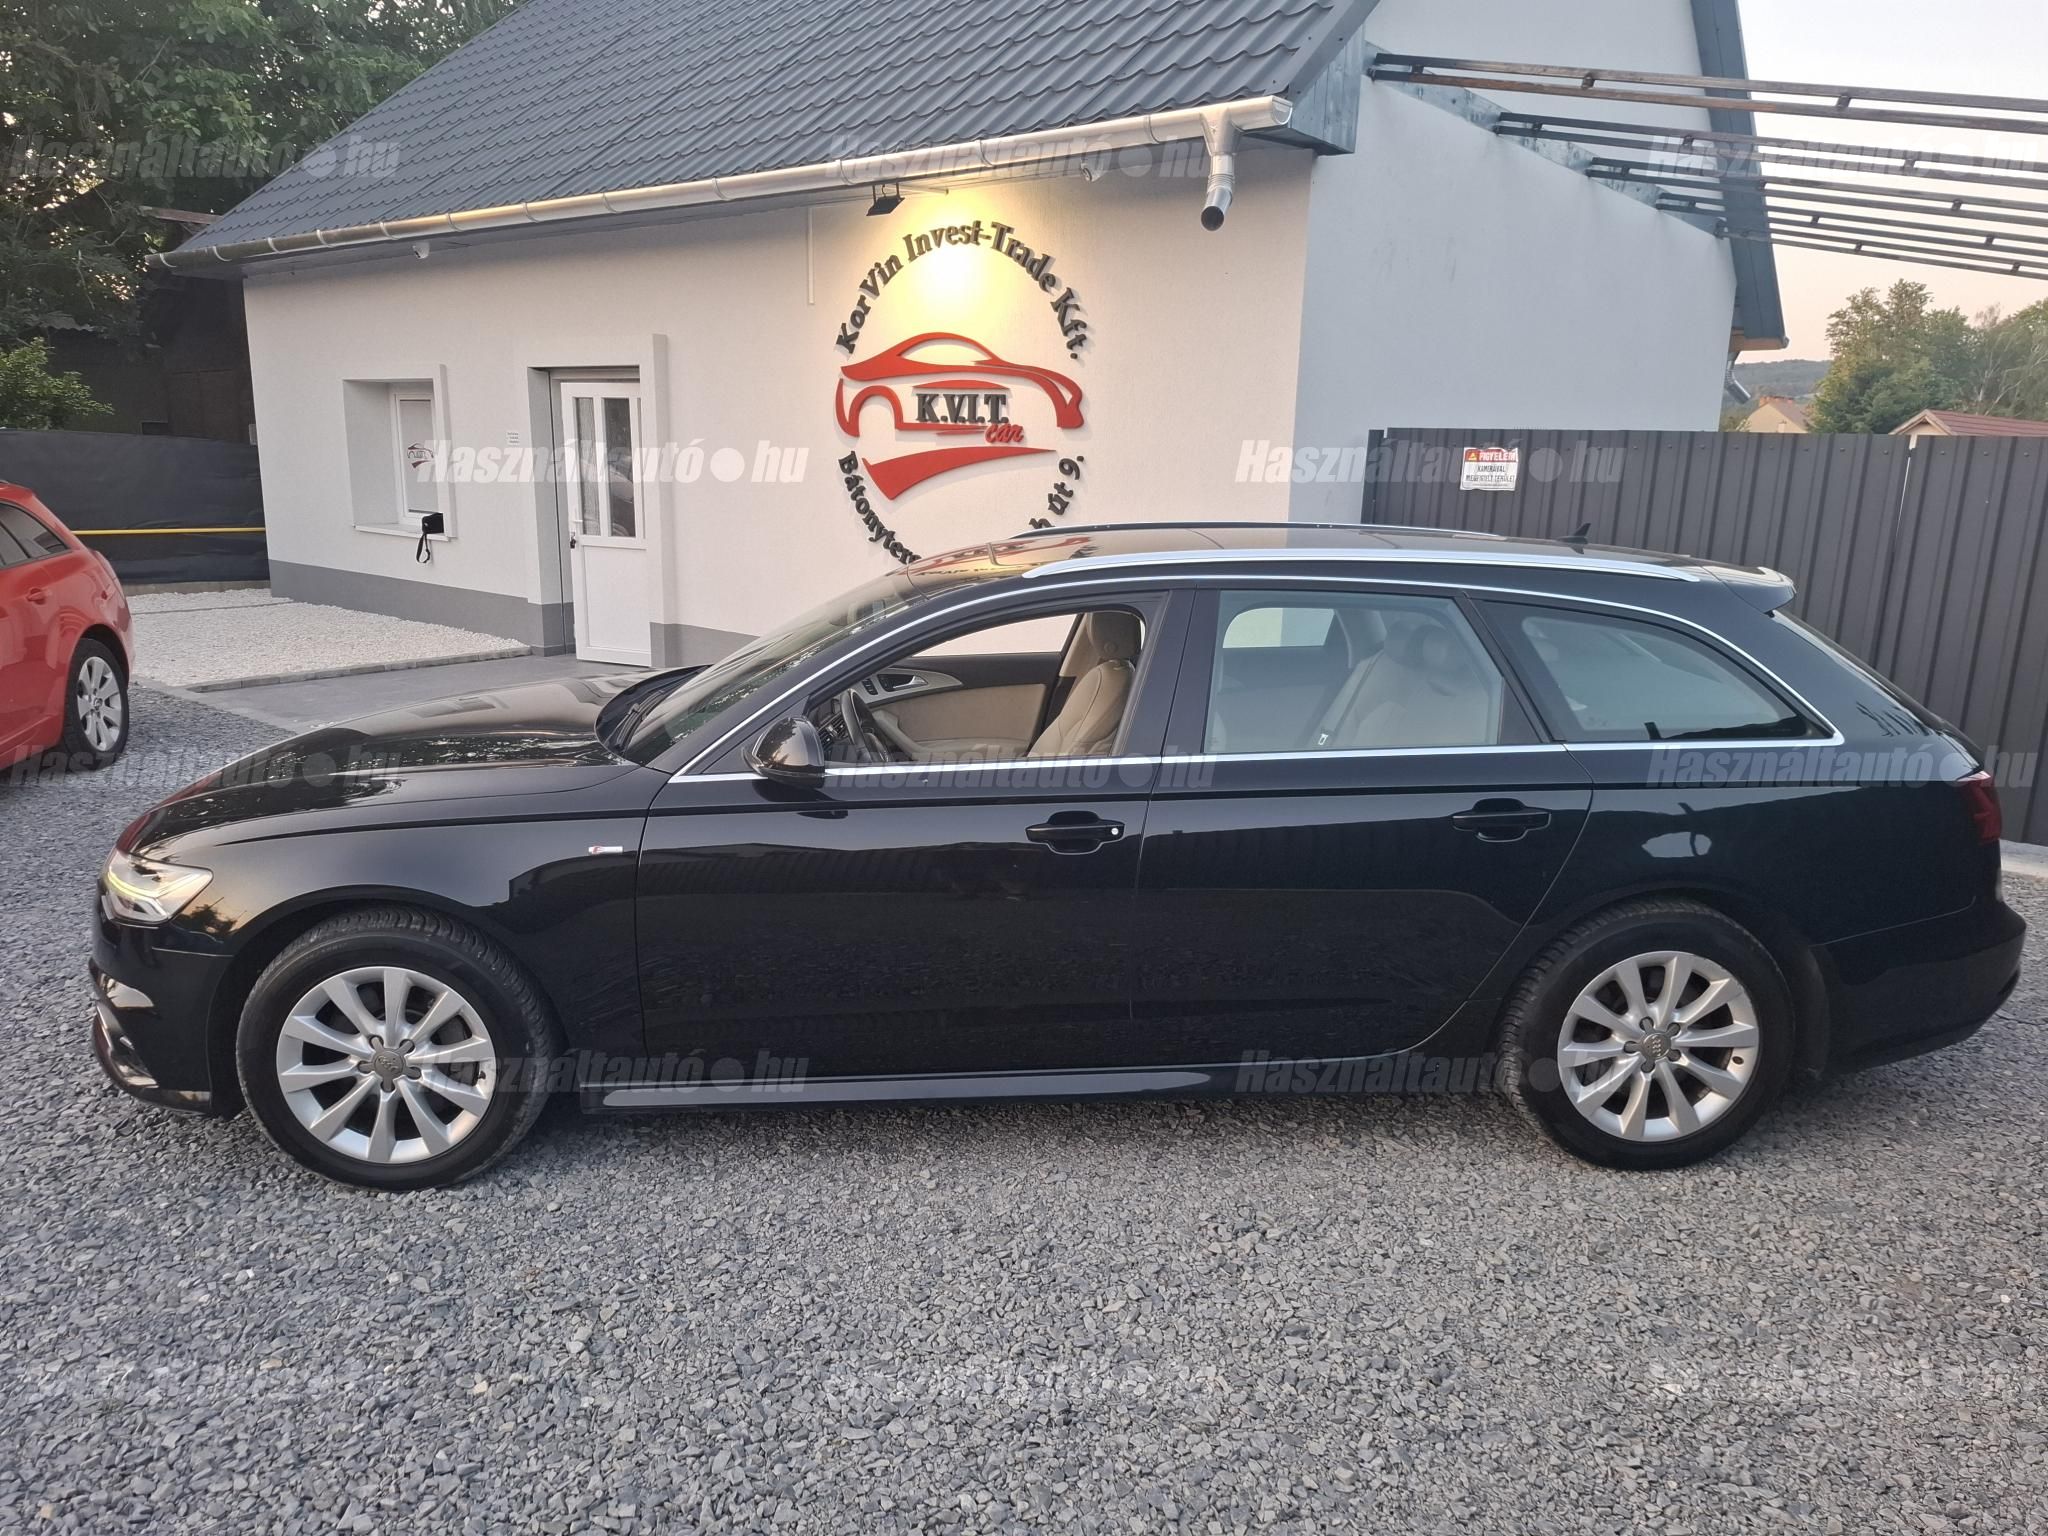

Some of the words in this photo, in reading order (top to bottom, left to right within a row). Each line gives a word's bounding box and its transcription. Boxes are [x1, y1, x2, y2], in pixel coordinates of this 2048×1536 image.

[902, 220, 1057, 292] Invest-Trade
[1050, 287, 1088, 360] Kft.
[916, 393, 1009, 424] K.V.I.T.
[1058, 455, 1085, 480] 9.
[838, 450, 922, 565] Bátonyter
